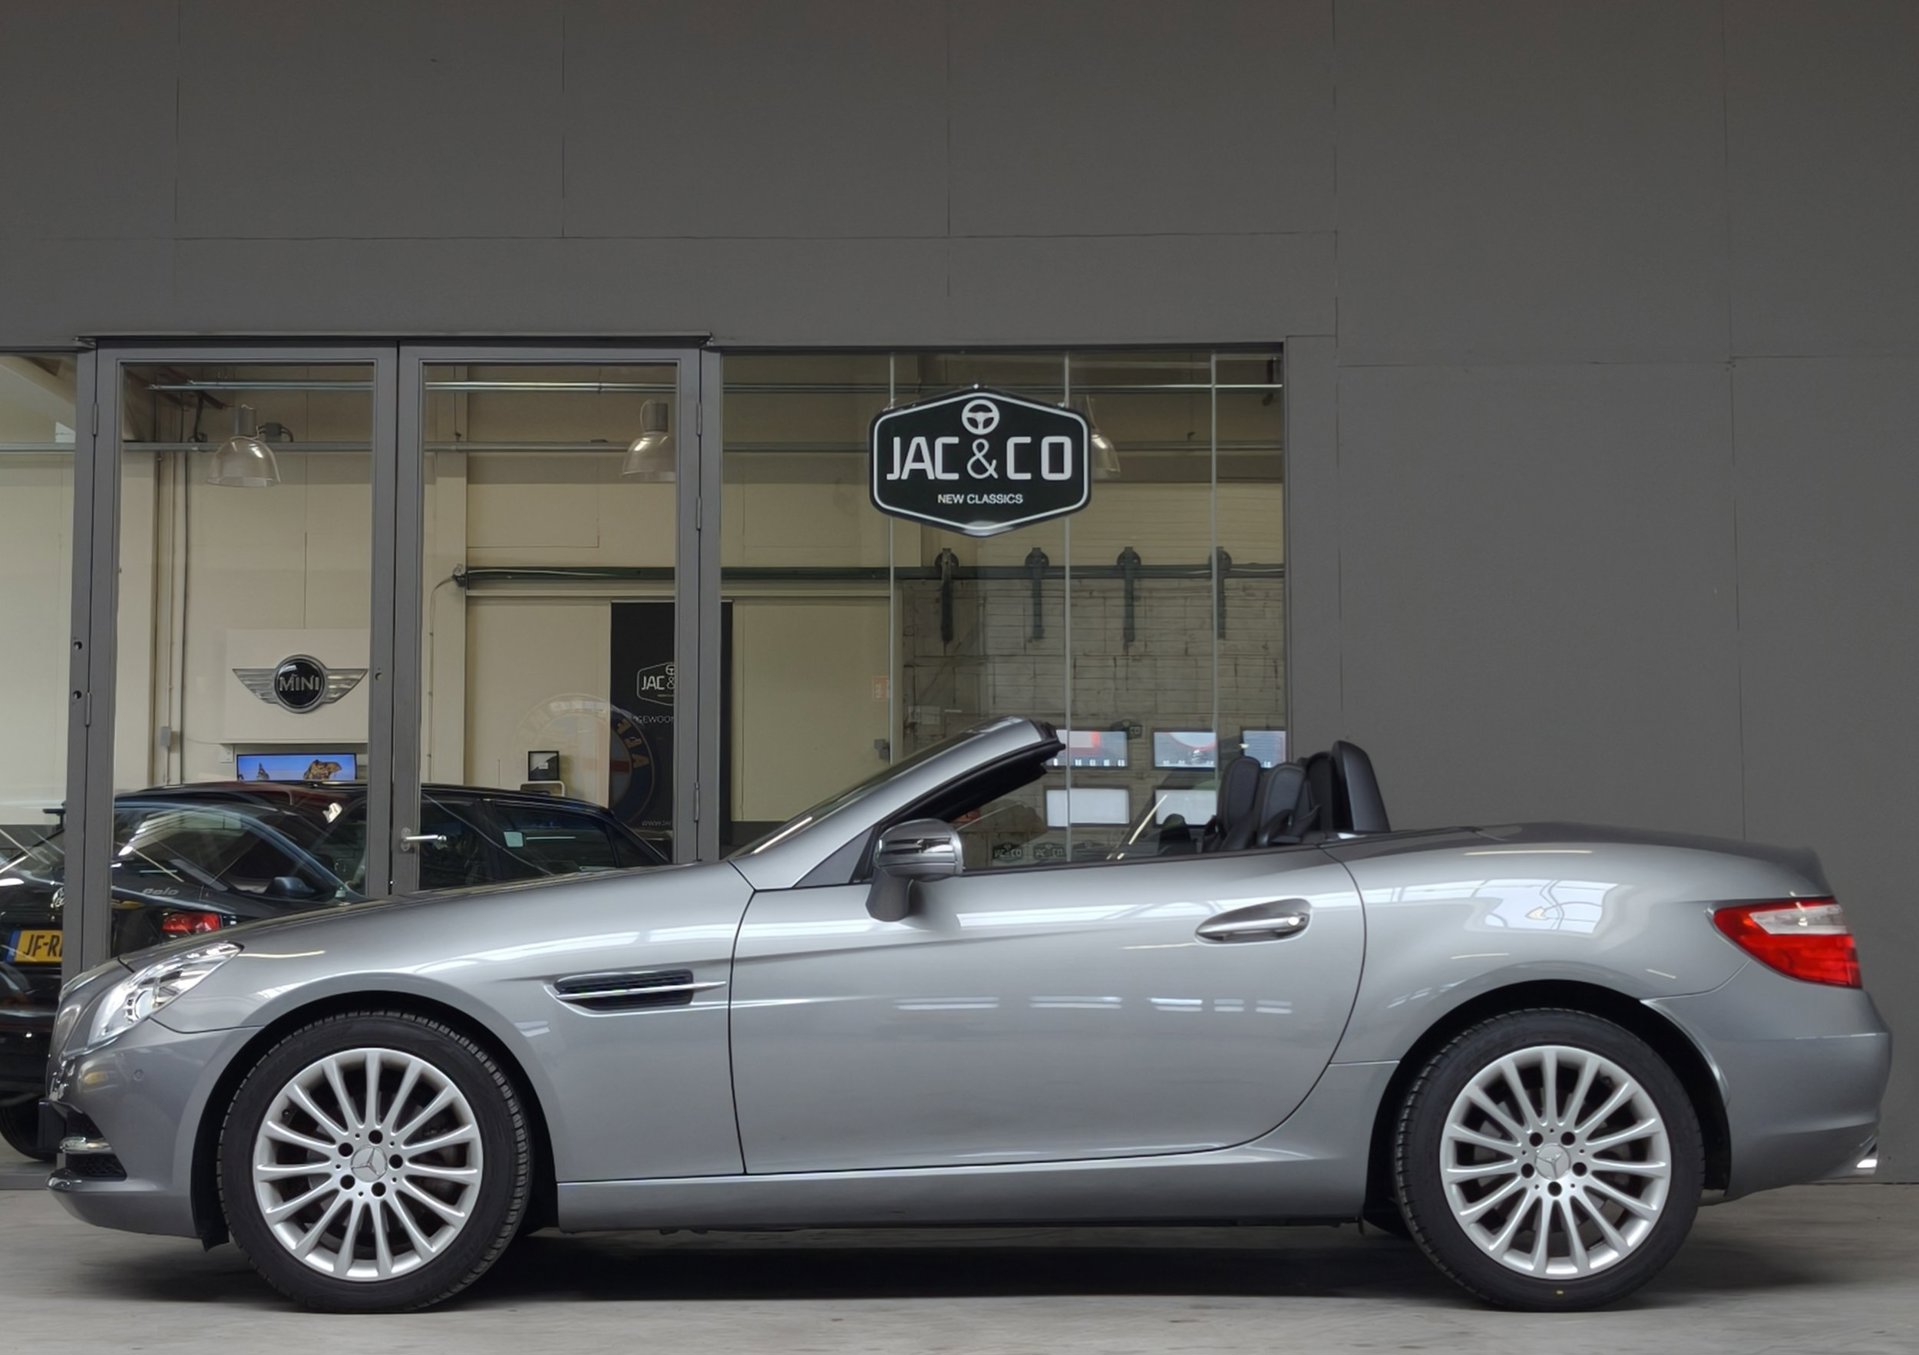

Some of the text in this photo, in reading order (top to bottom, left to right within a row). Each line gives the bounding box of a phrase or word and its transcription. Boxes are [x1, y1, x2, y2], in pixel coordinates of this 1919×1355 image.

[937, 493, 1023, 504] NEW CLASSICS
[279, 675, 319, 691] MINI
